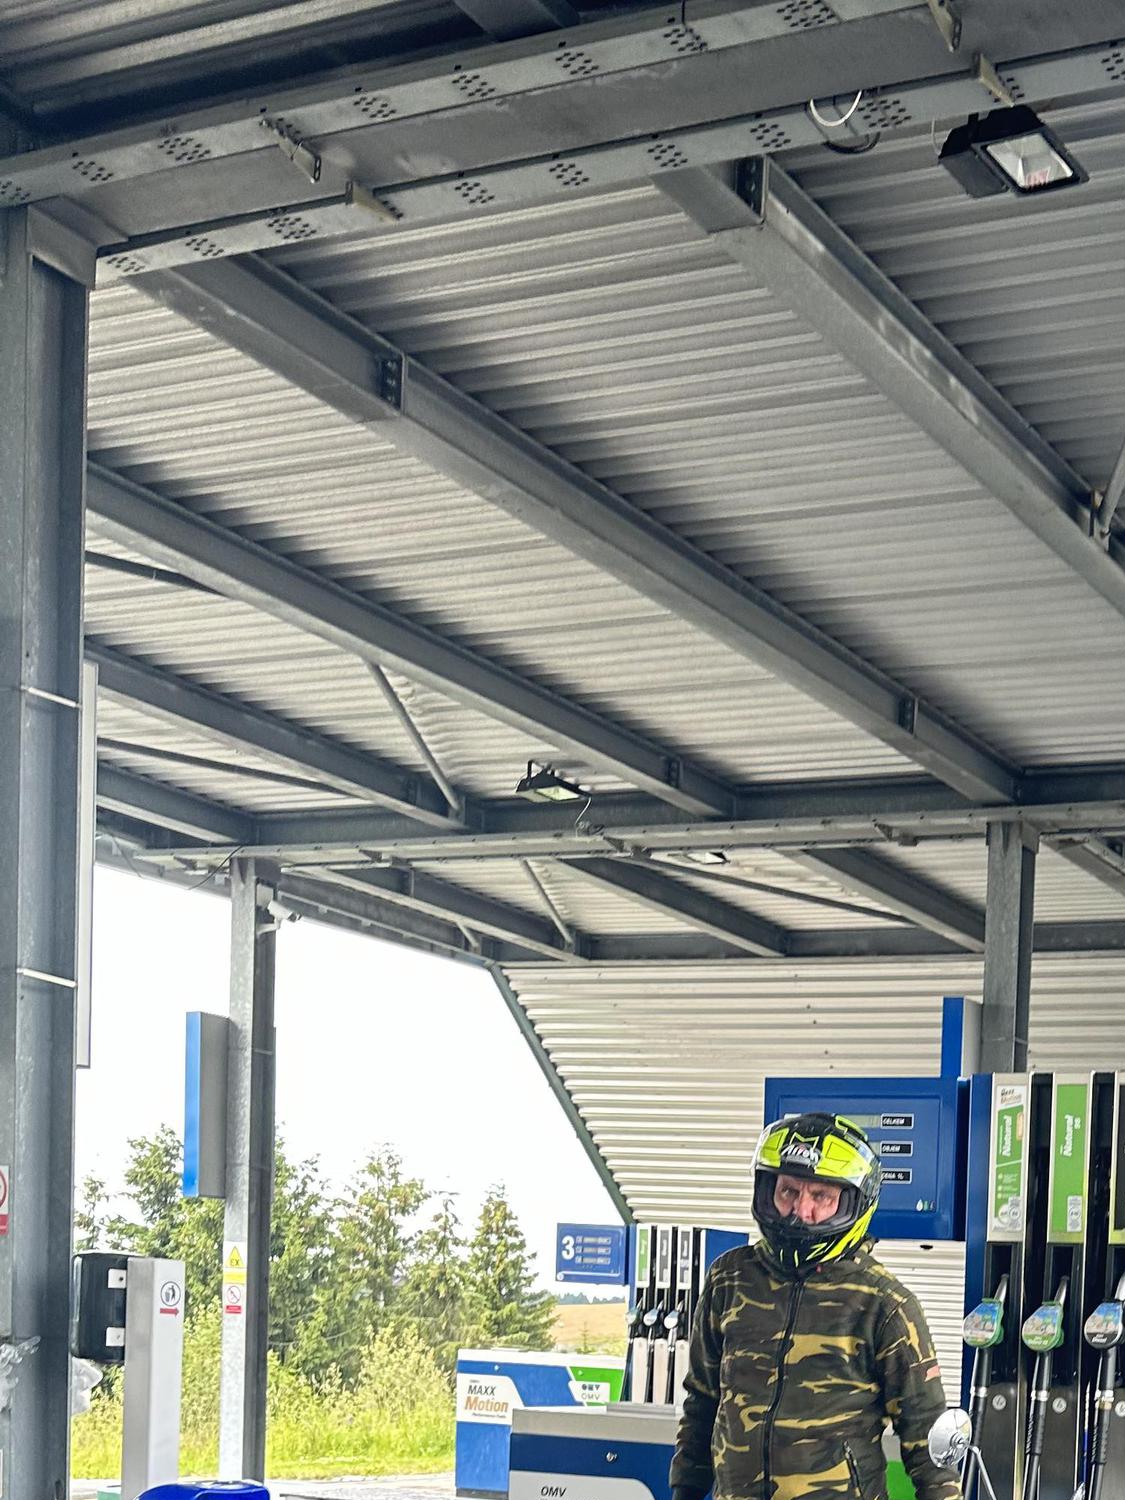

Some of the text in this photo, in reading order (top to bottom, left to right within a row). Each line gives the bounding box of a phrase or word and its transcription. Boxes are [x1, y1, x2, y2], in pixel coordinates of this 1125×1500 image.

[1063, 1114, 1074, 1157] Natural
[562, 1235, 575, 1260] 3
[230, 1259, 240, 1267] EX
[467, 1384, 496, 1396] MAXX
[464, 1394, 509, 1413] Motion
[540, 1485, 567, 1497] OMV
